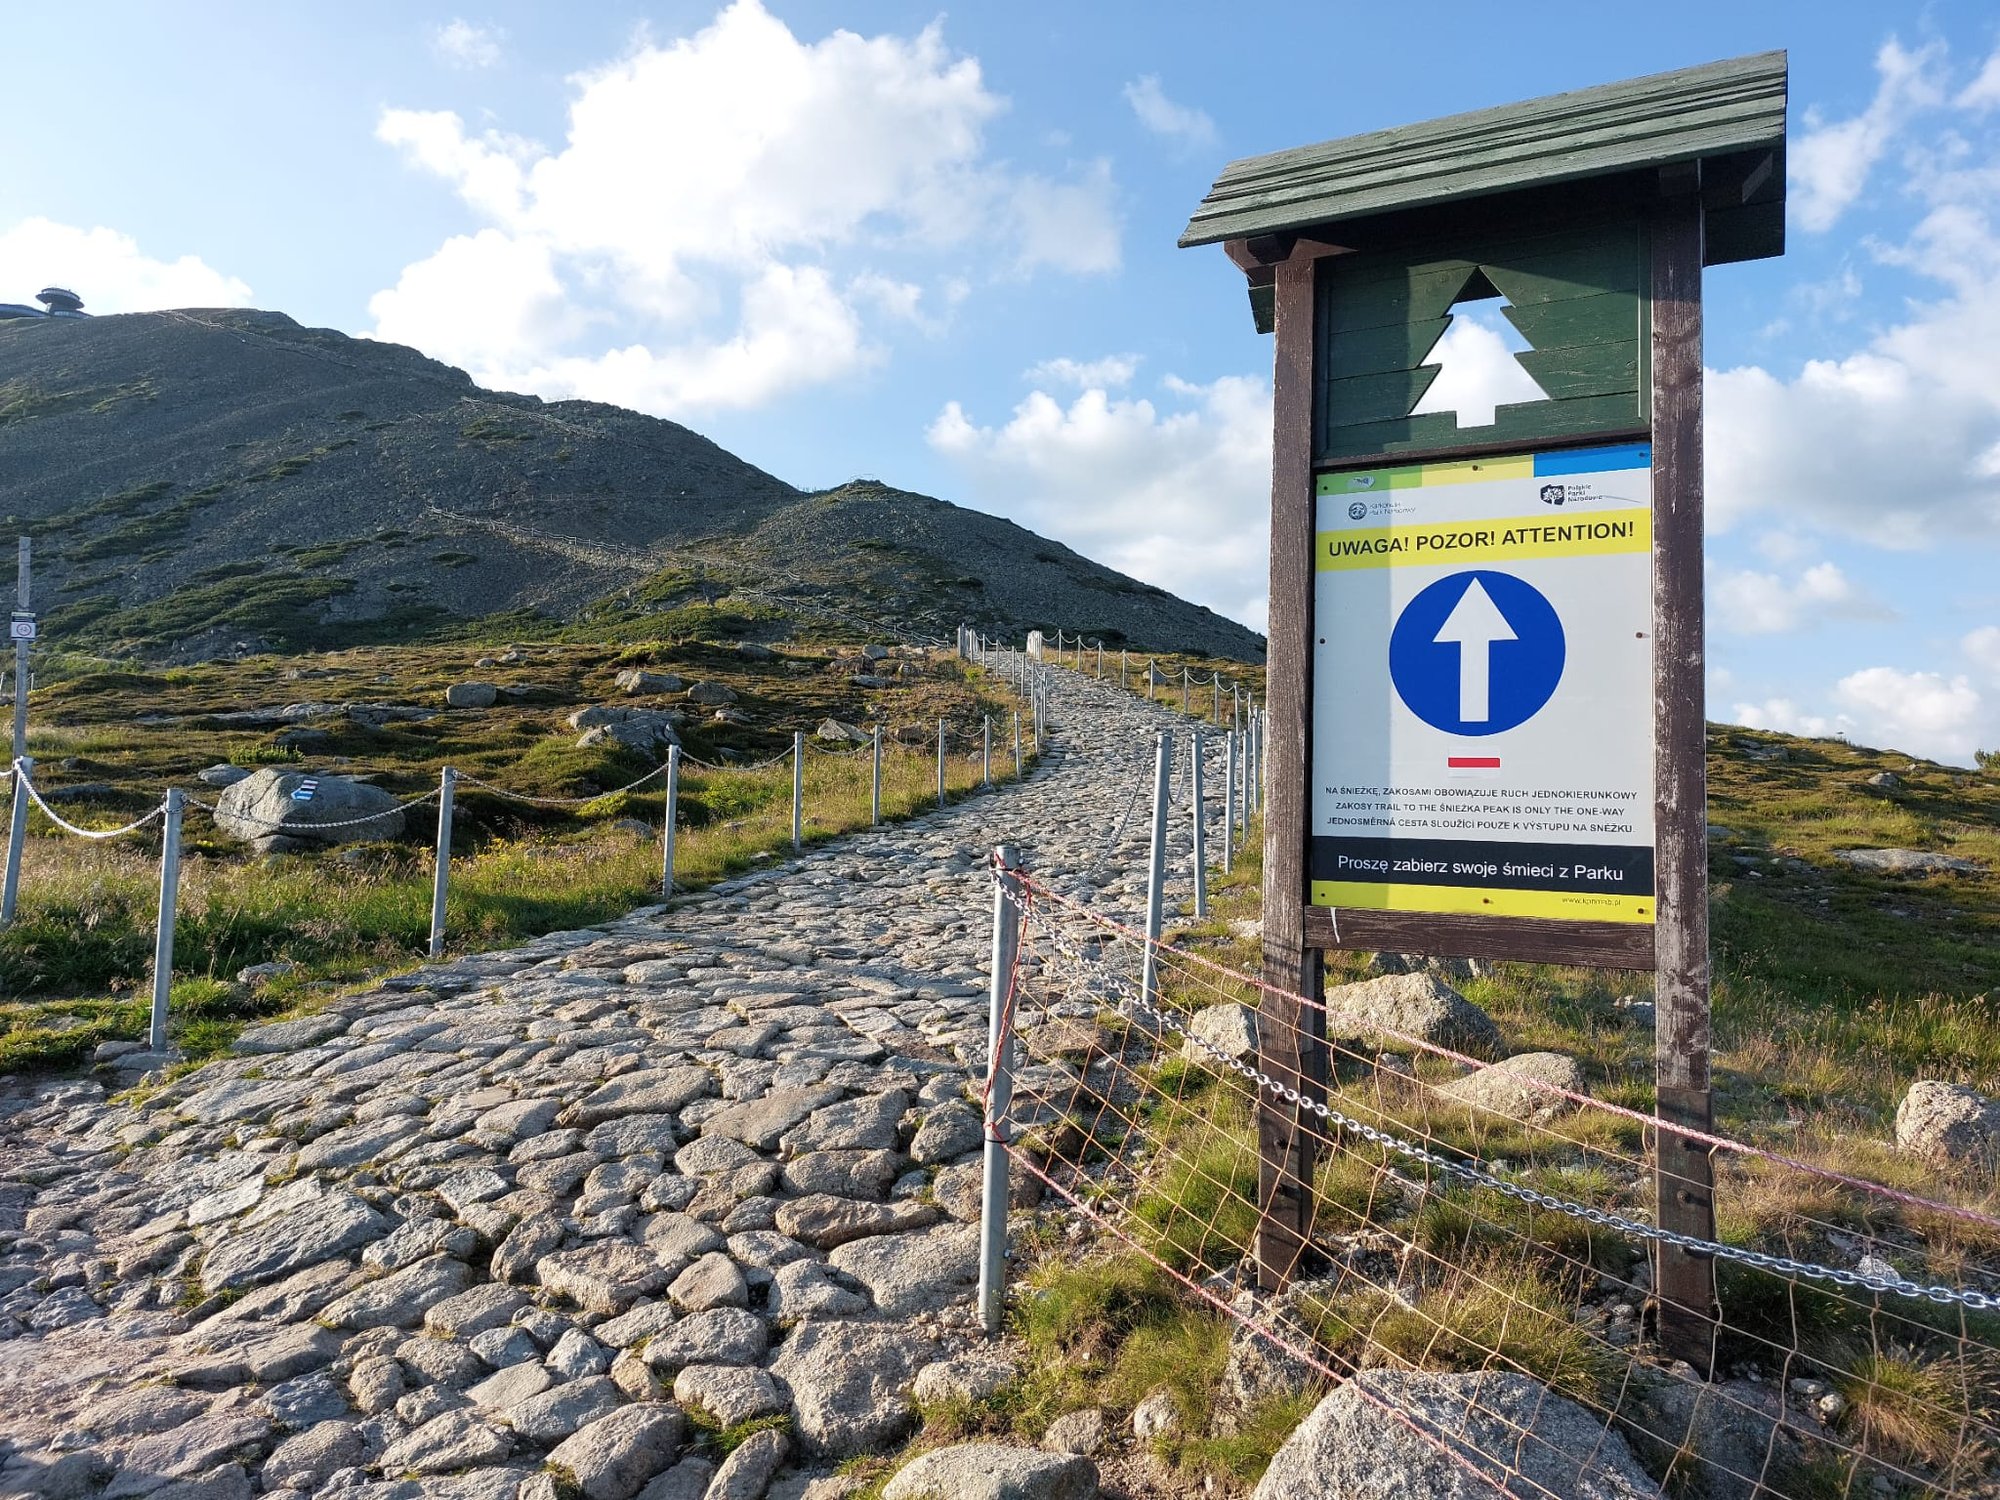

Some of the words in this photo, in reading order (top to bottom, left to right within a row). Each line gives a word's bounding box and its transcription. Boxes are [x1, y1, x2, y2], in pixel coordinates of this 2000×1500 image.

[1329, 536, 1409, 557] UWAGA!
[1416, 531, 1495, 551] POZOR!
[1502, 521, 1634, 546] ATTENTION!
[1325, 787, 1338, 795] NA
[1382, 788, 1432, 796] ZAKOSAMI
[1434, 788, 1498, 798] OBOWIĄZUJE
[1501, 789, 1529, 798] RUCH
[1532, 790, 1637, 800] JEDNOKIERUNKOWY
[1335, 802, 1373, 811] ZAKOSY
[1375, 803, 1401, 811] TRAIL
[1419, 804, 1437, 812] THE
[1439, 803, 1480, 813] ŚNIEŻKA
[1483, 805, 1510, 814] PEAK
[1512, 806, 1522, 814] IS
[1524, 806, 1551, 815] ONLY
[1554, 807, 1574, 815] THE
[1576, 807, 1625, 816] ONE-WAY
[1398, 818, 1428, 827] CESTA
[1477, 820, 1511, 829] POUZE
[1513, 821, 1520, 829] K
[1573, 824, 1587, 832] NA
[1338, 855, 1389, 874] Proszę
[1393, 858, 1448, 873] zabierz
[1452, 861, 1498, 877] swoje
[1502, 861, 1554, 878] śmieci
[1559, 867, 1569, 878] z
[1574, 864, 1623, 880] Parku
